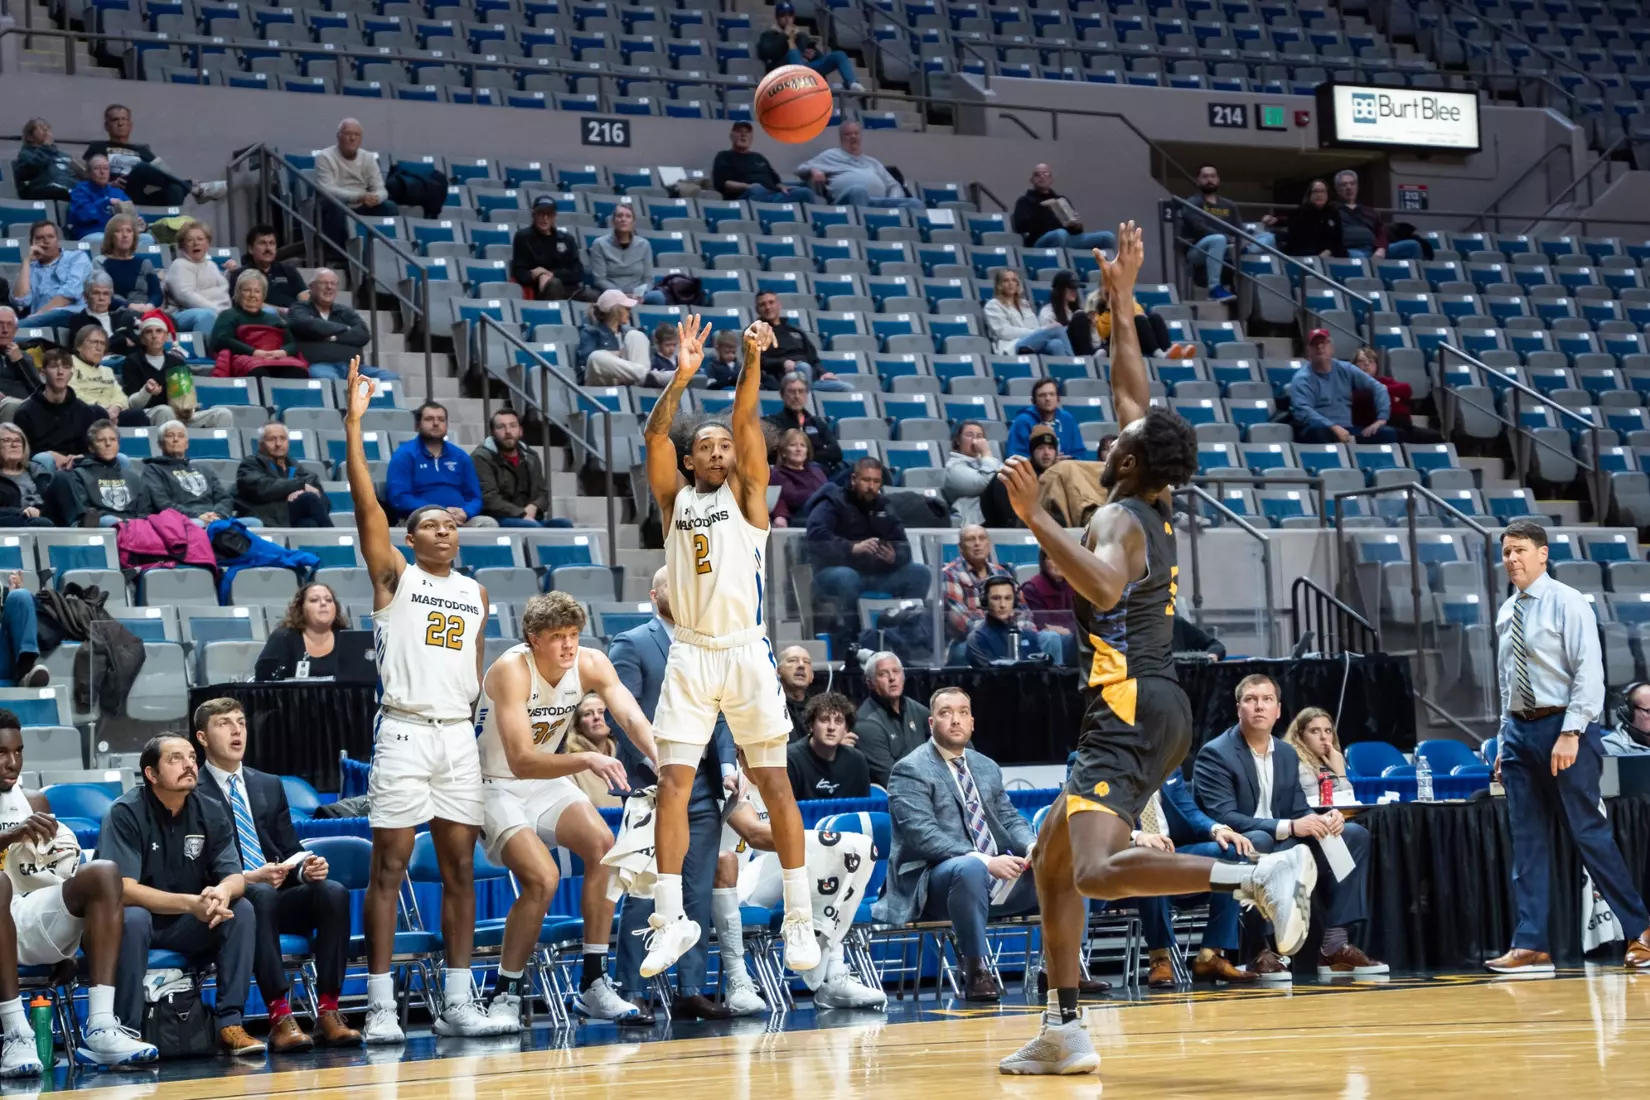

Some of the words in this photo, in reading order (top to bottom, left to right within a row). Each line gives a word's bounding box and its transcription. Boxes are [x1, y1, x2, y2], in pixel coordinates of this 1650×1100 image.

[1213, 106, 1243, 125] 214
[1379, 94, 1419, 119] Burt
[1422, 97, 1461, 121] Blee
[588, 120, 625, 143] 216
[693, 533, 712, 575] 2
[411, 593, 479, 615] MASTODONS
[425, 611, 465, 651] 22
